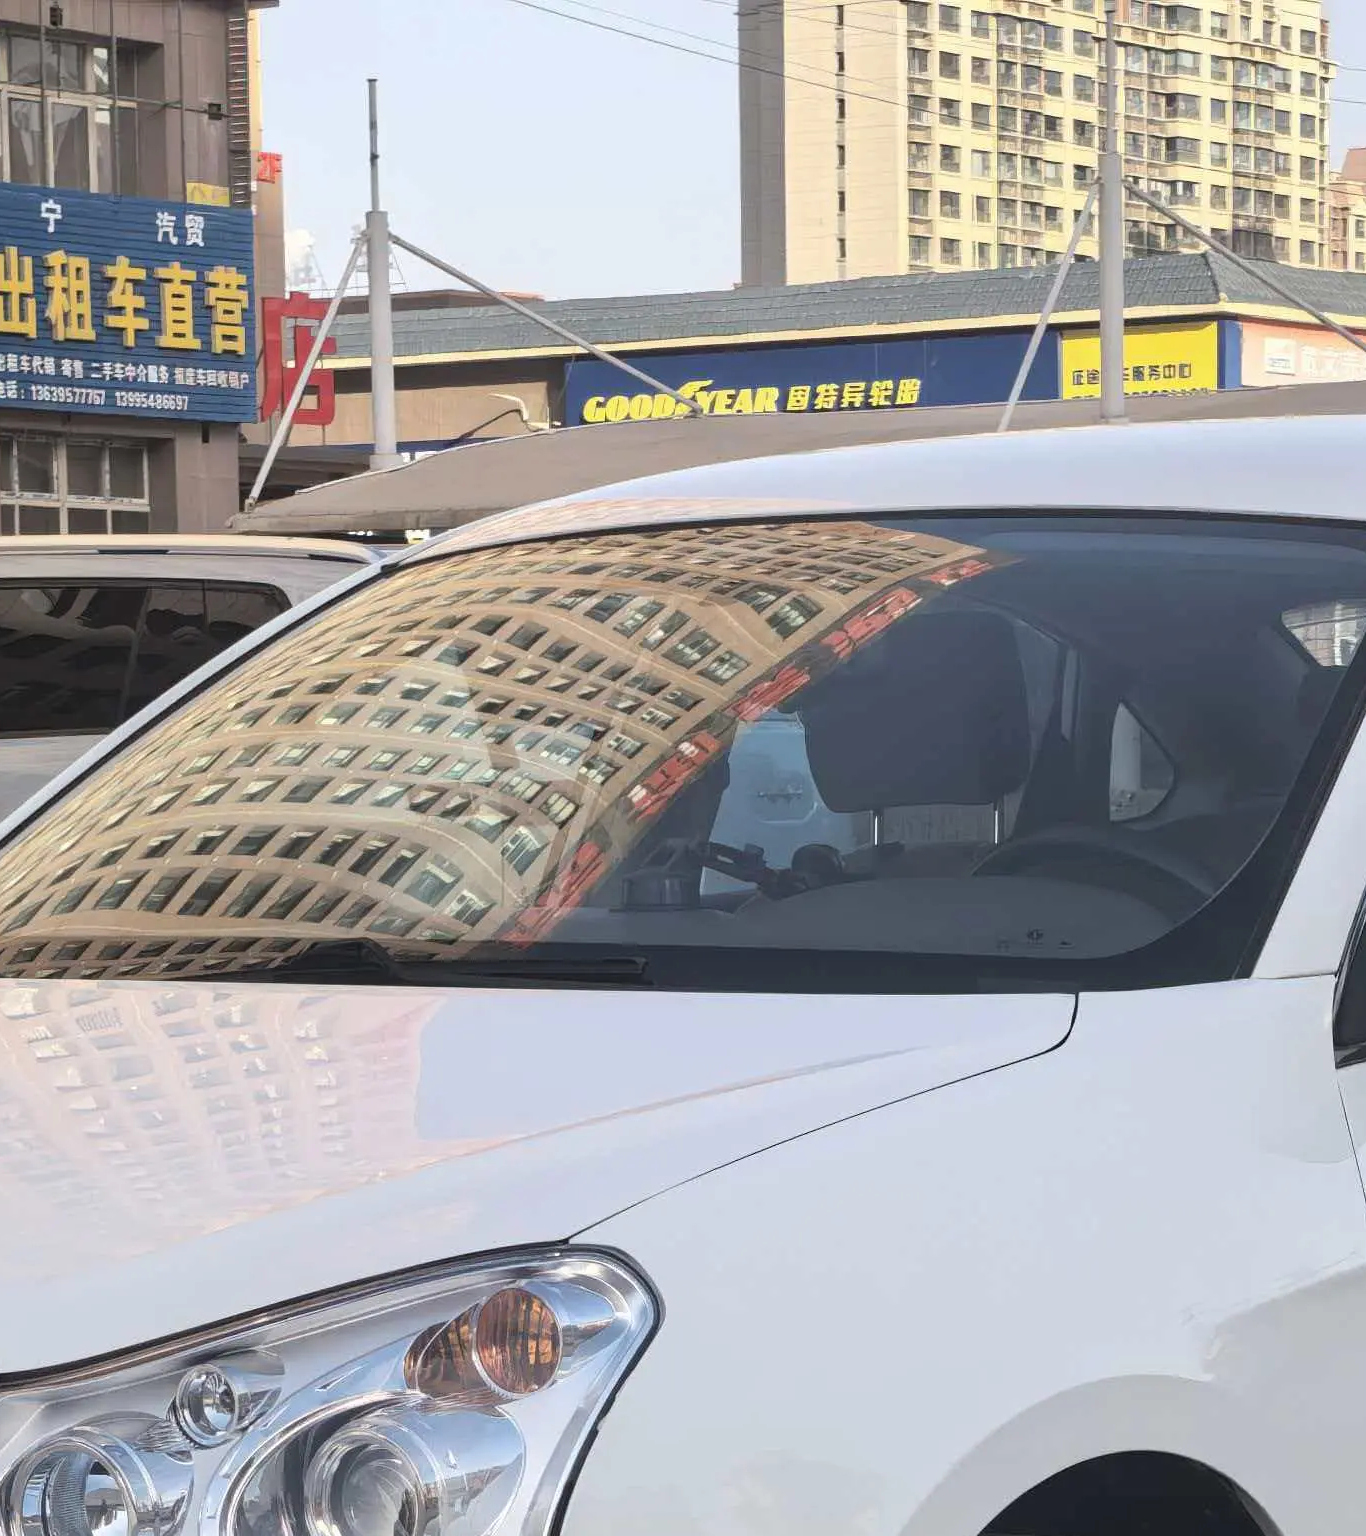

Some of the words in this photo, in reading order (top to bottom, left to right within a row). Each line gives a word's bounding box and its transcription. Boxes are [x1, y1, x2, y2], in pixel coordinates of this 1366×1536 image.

[40, 199, 62, 233] 宁
[155, 211, 205, 246] 汽贸
[91, 361, 169, 385] 二手车中介服务
[261, 291, 337, 426] 店
[583, 381, 779, 422] GOODYEAR
[786, 379, 921, 411] 固特异轮胎
